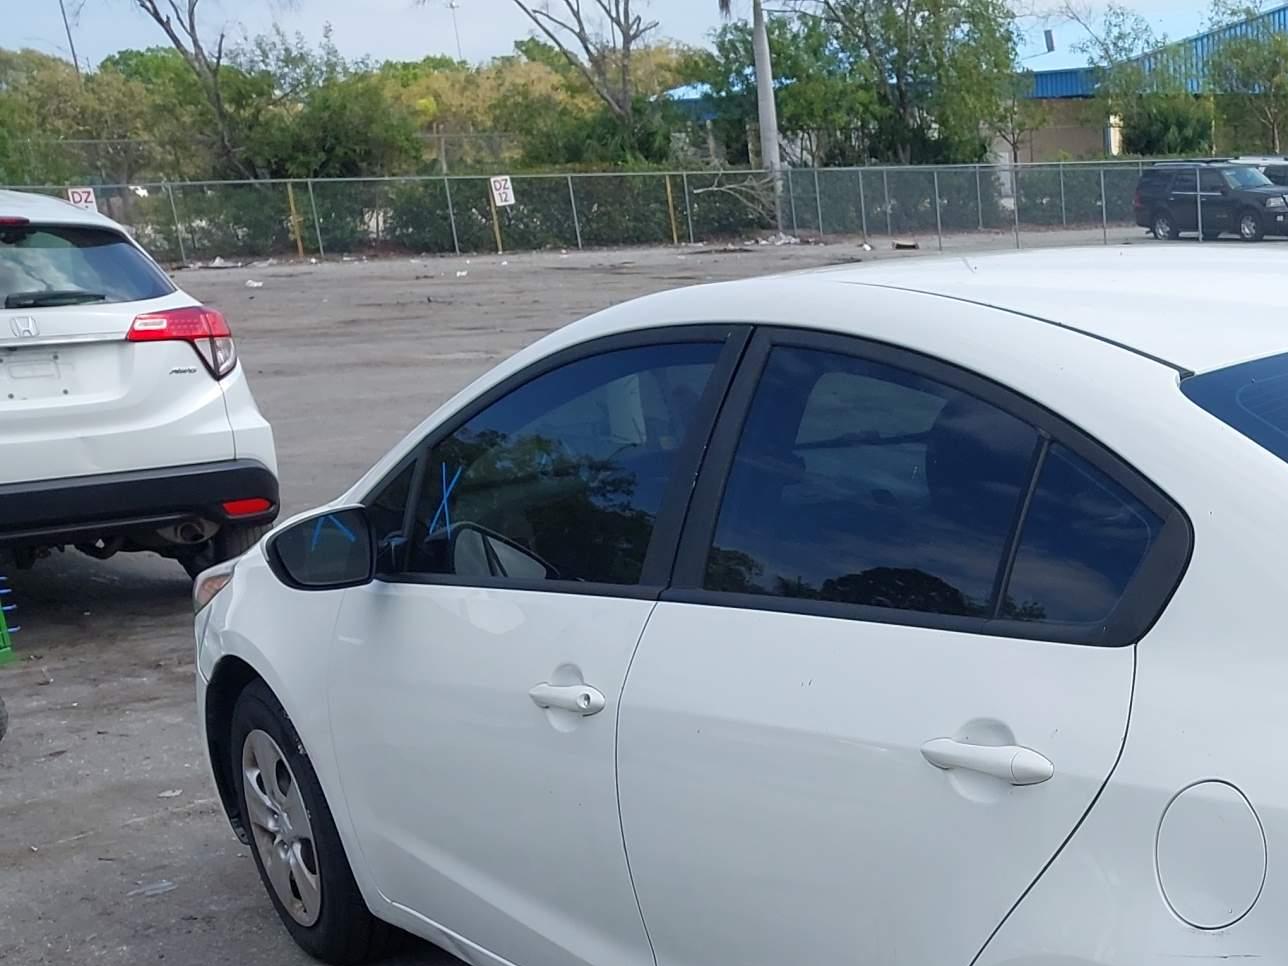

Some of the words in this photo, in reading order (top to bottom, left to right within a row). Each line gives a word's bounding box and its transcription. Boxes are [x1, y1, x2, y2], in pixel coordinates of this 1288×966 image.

[493, 178, 510, 191] DZ
[71, 190, 93, 204] DZ
[498, 192, 509, 203] 12
